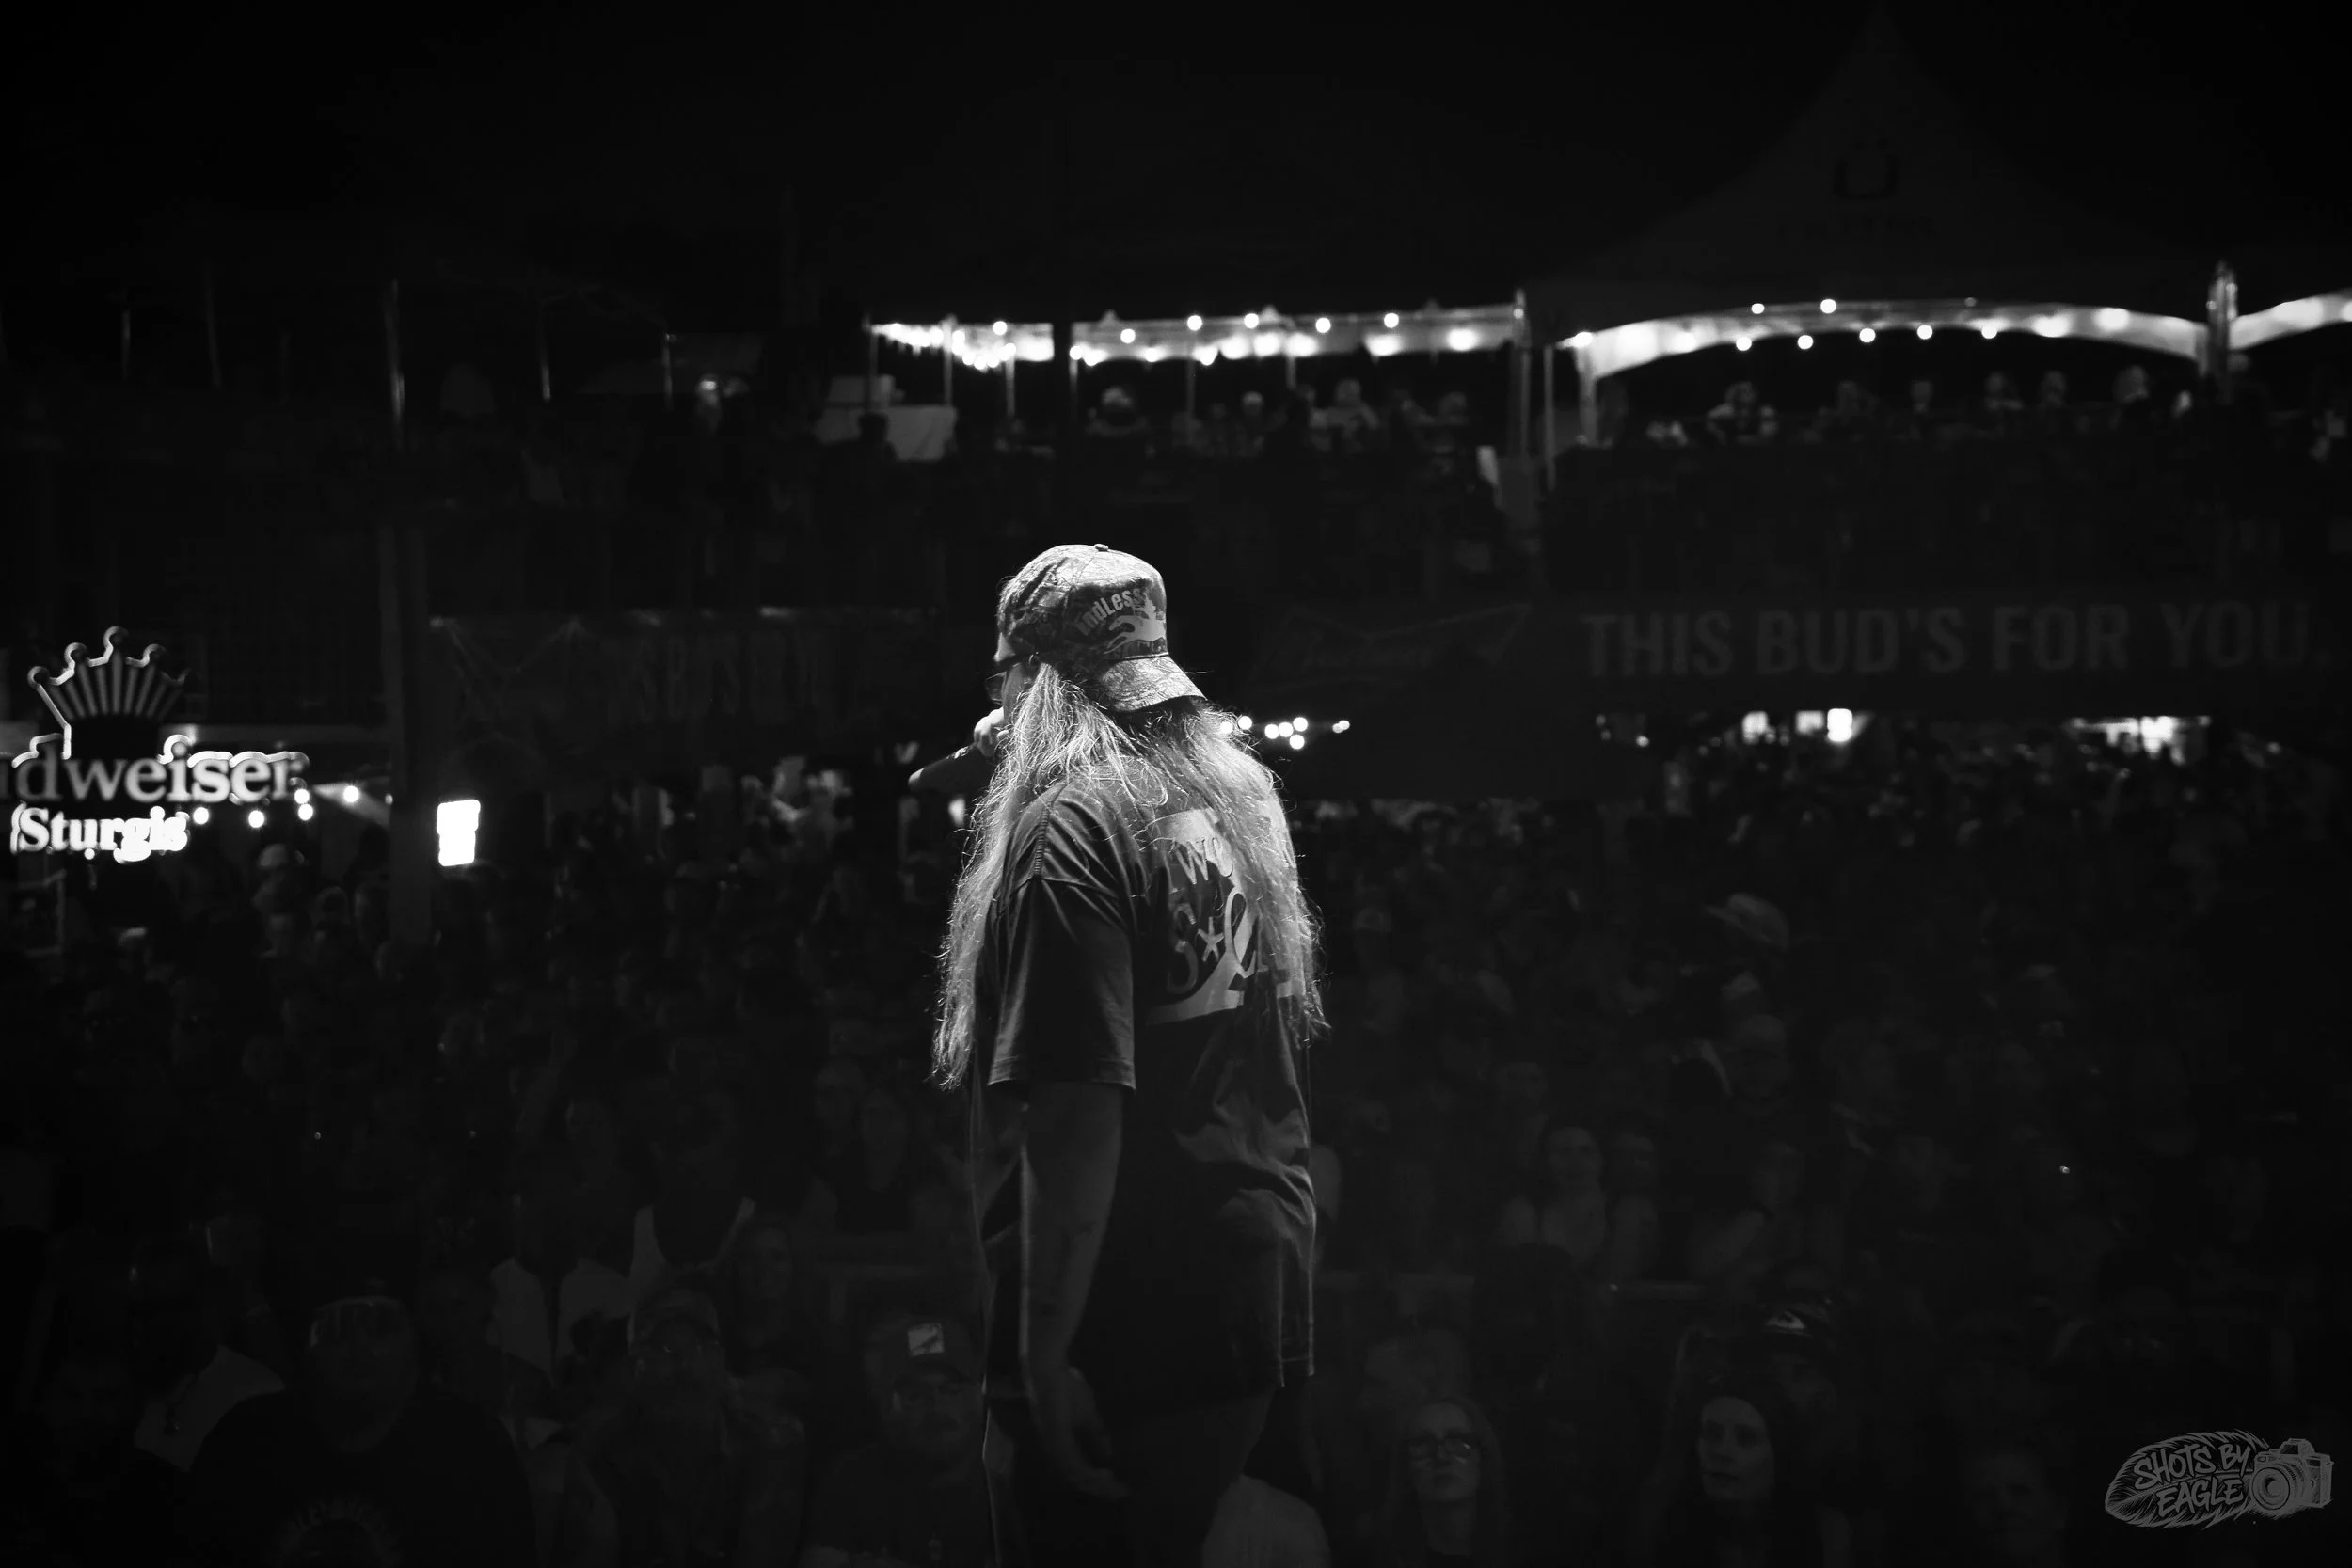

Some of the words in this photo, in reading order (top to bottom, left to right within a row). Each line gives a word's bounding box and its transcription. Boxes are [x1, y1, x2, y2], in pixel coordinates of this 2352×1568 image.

[1578, 610, 1733, 677] THIS
[1754, 606, 1964, 675] BUD'S
[1989, 602, 2128, 672] FOR
[13, 805, 190, 863] Sturgis
